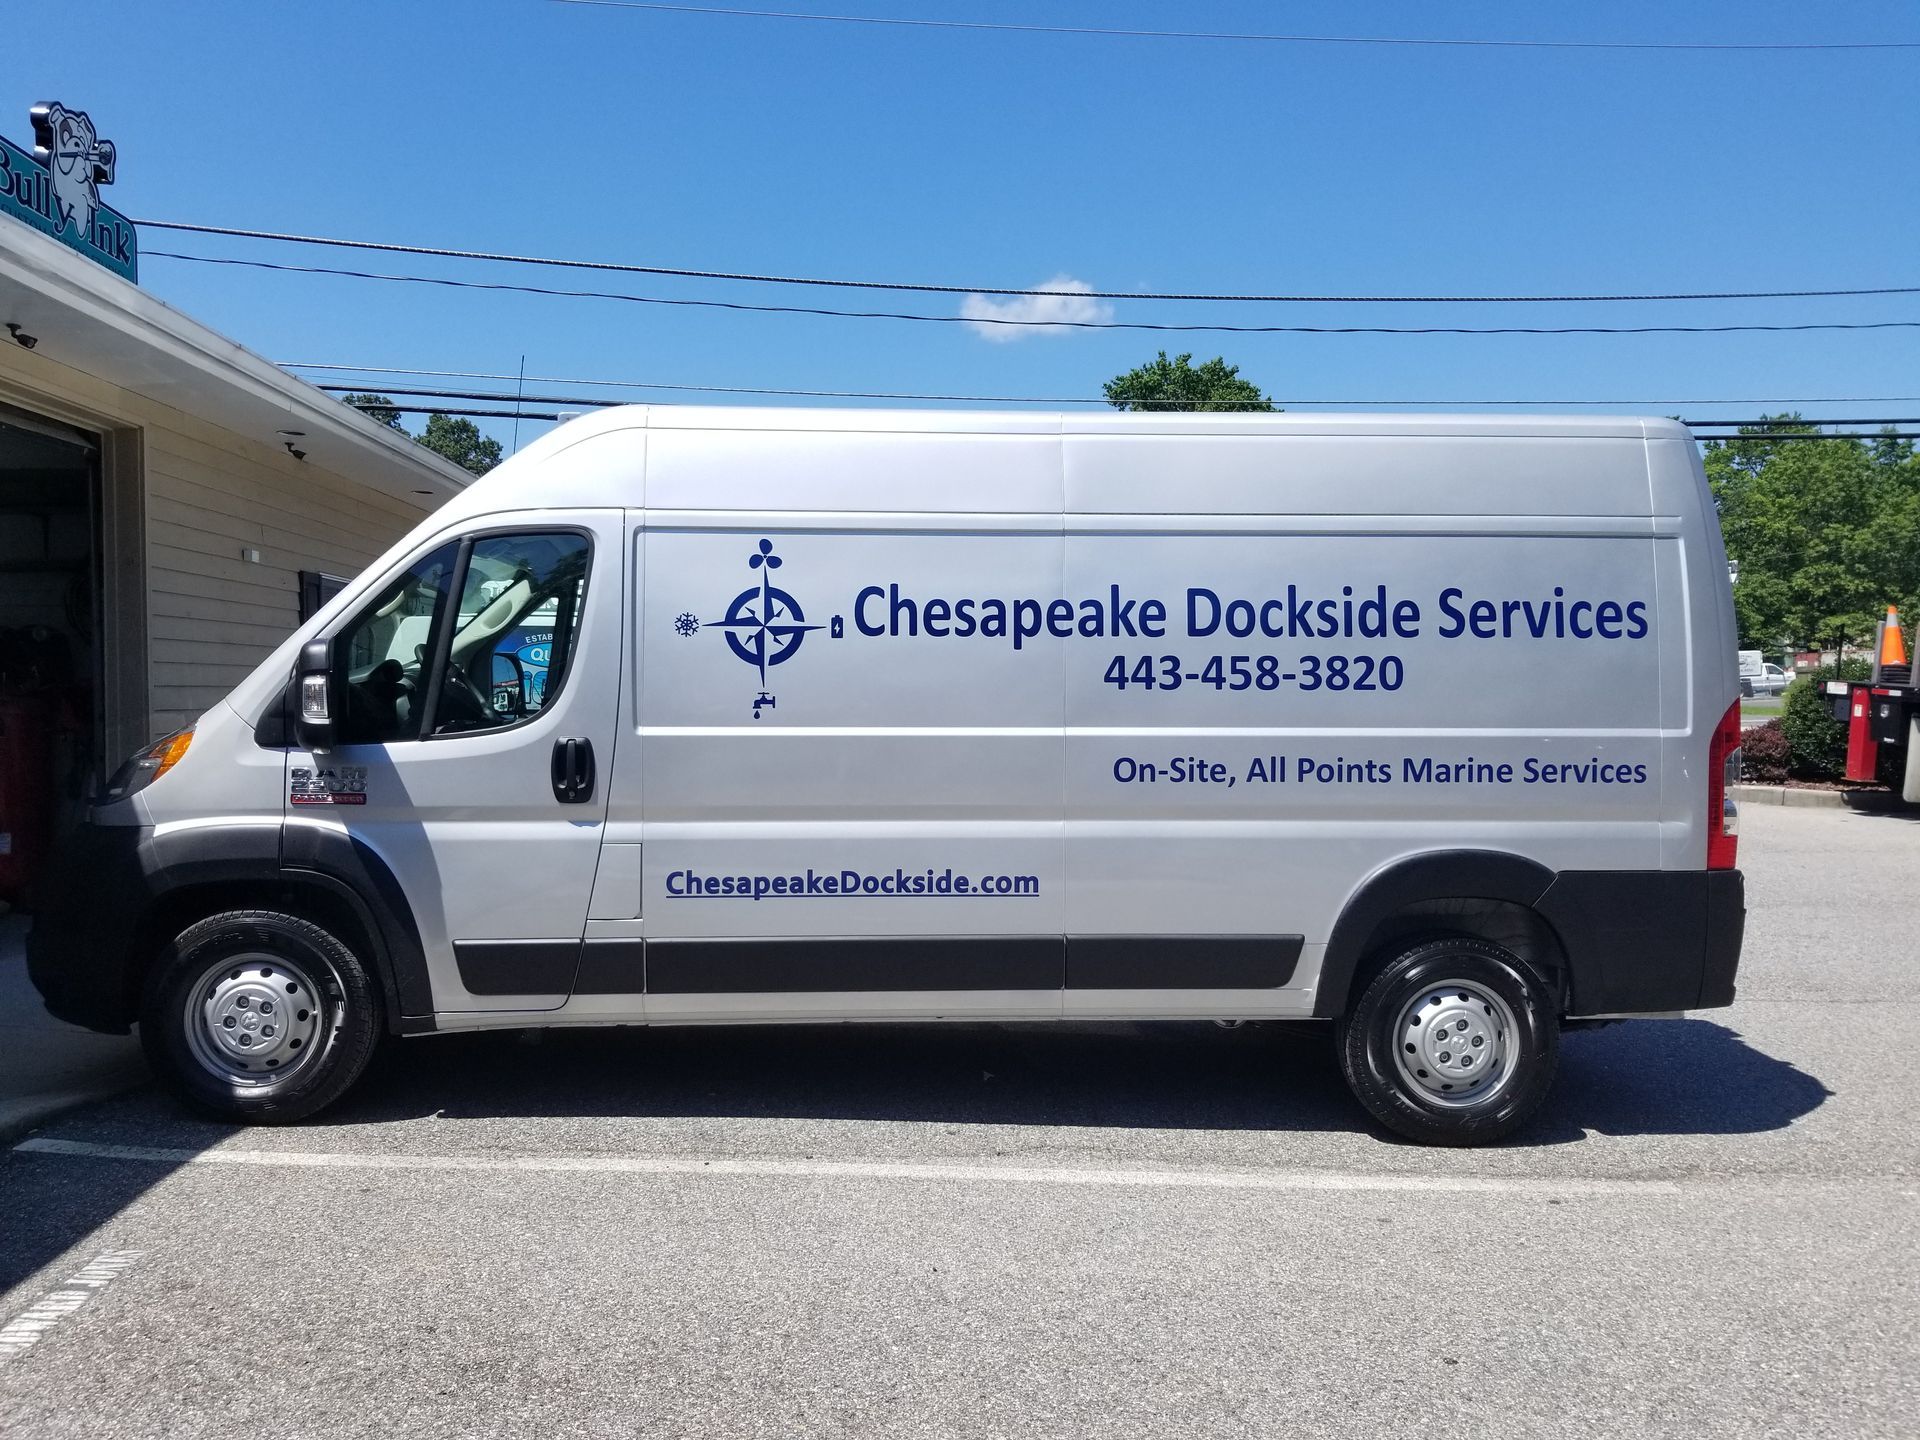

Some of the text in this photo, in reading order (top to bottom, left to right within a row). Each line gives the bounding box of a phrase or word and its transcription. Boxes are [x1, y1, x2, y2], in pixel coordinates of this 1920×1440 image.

[0, 144, 131, 267] Bully Ink
[855, 583, 1649, 651] Chesapeake Dockside Services
[1103, 655, 1404, 692] 443-458-3820
[1113, 755, 1647, 788] On-Site, All Points Marine Services
[665, 868, 1039, 901] ChesapeakeDockside.com
